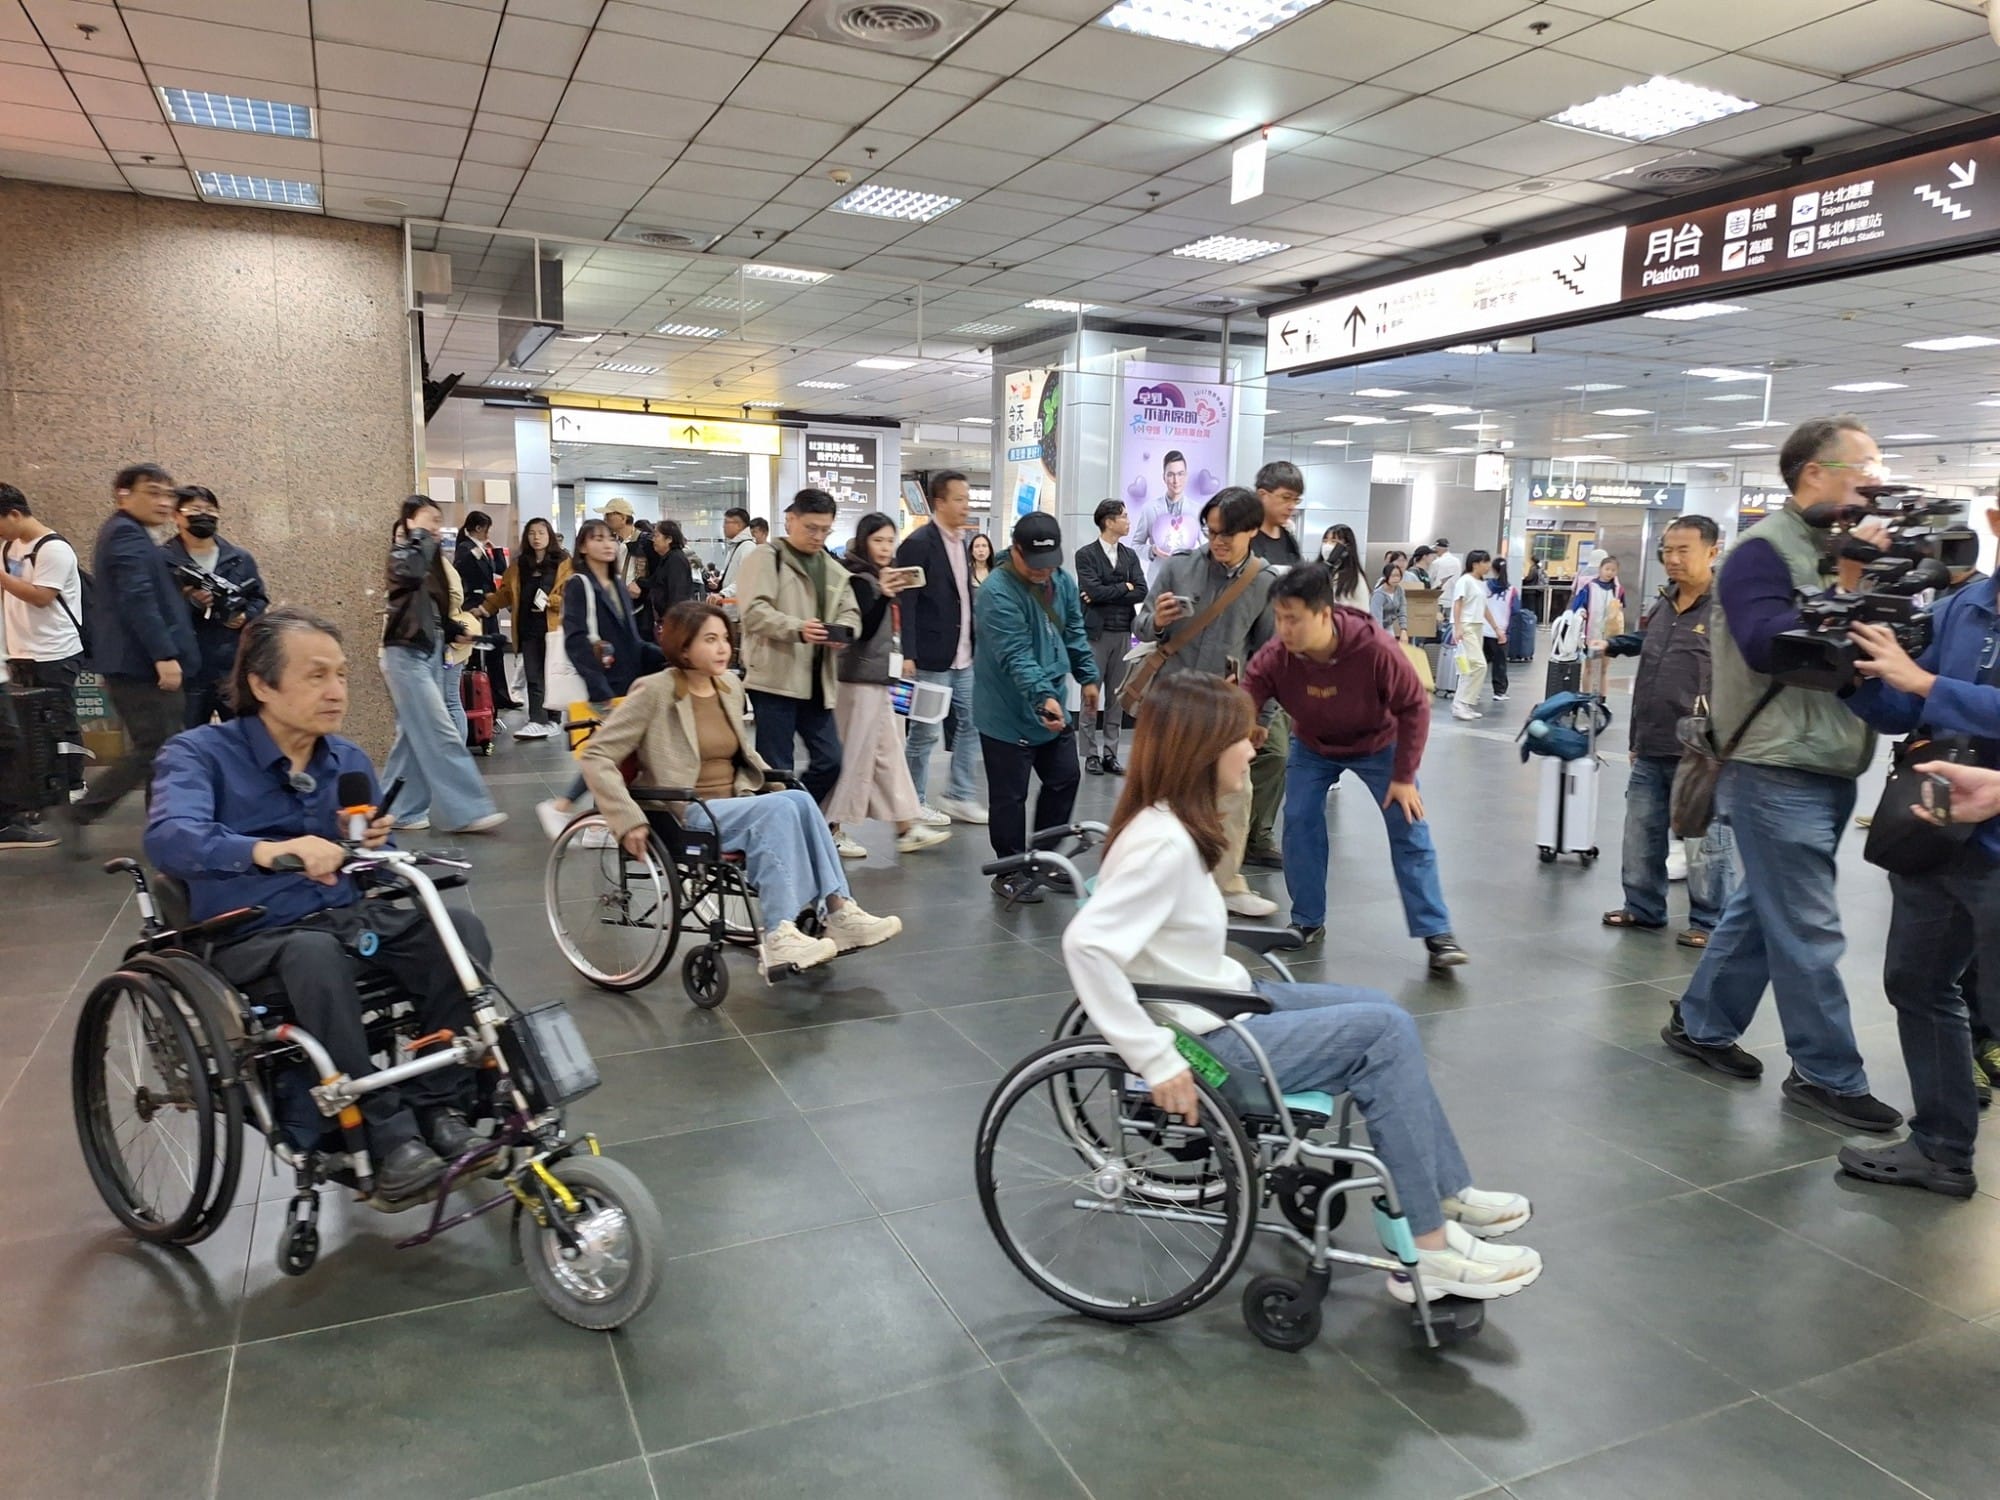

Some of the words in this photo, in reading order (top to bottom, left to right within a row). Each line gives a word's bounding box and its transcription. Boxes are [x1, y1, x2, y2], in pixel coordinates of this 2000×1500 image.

[1821, 180, 1875, 206] 台北捷運
[1820, 203, 1844, 218] Taipei
[1845, 199, 1869, 211] Metro
[1751, 222, 1767, 232] TRA
[1818, 213, 1883, 239] 臺北轉運站
[1644, 223, 1704, 266] 月台
[1817, 237, 1842, 251] Taipei
[1842, 234, 1856, 246] Bus
[1857, 230, 1884, 242] Station
[1747, 254, 1766, 266] HSR
[1642, 263, 1699, 287] Platform
[1009, 404, 1024, 421] 今天
[1144, 408, 1198, 424] 不缺席的
